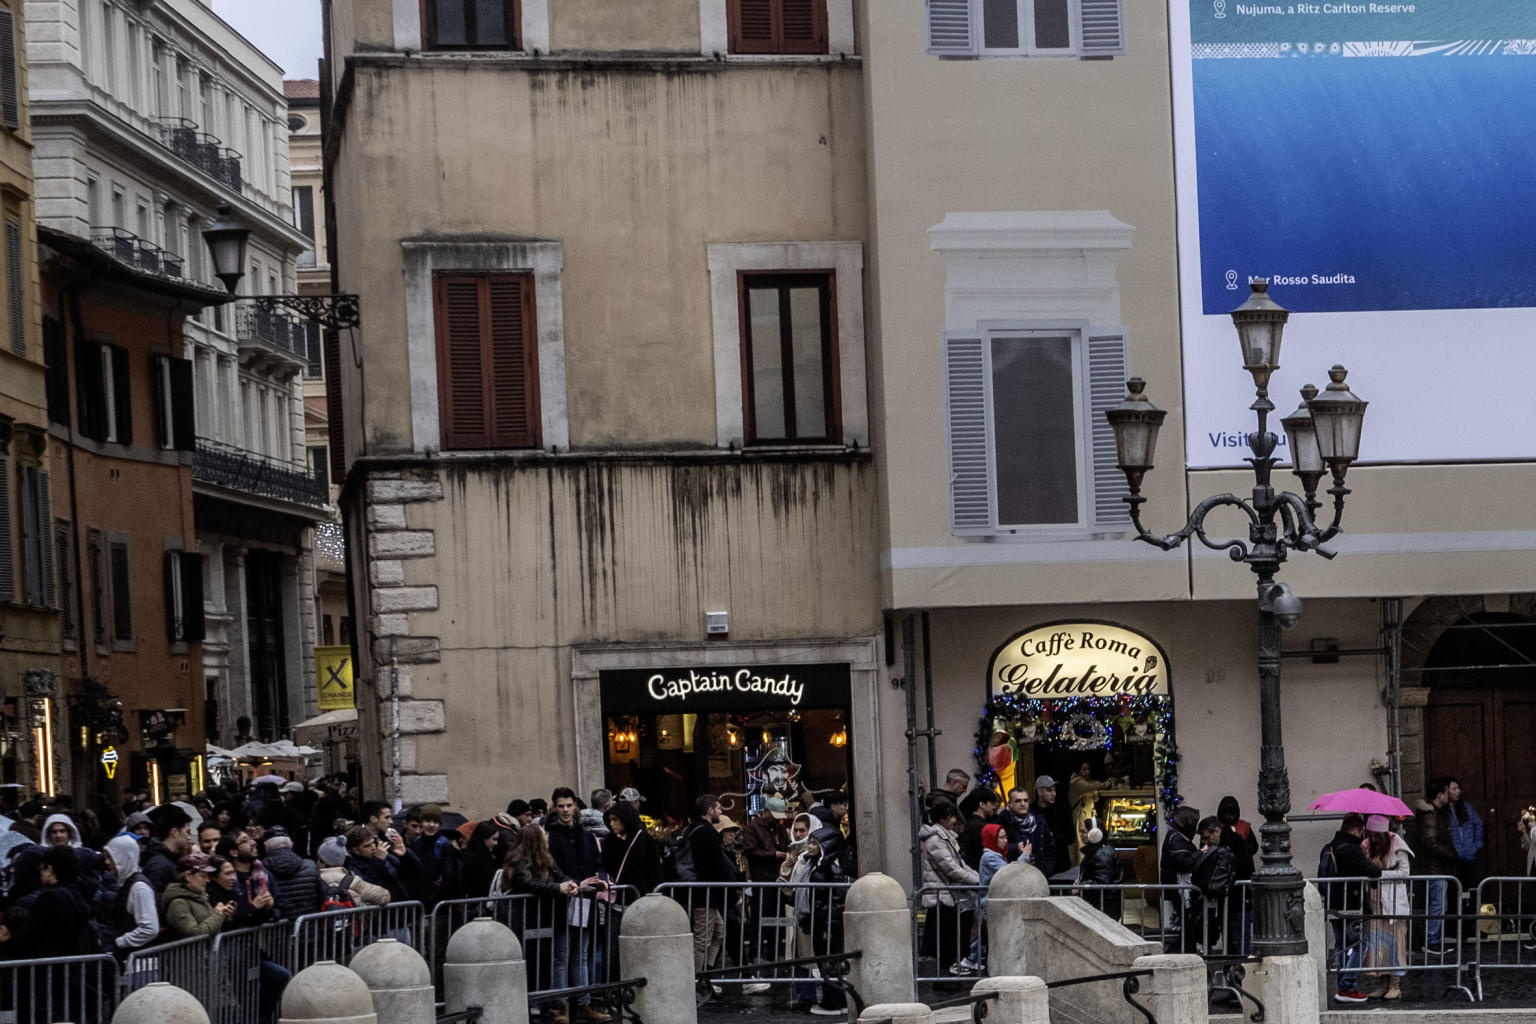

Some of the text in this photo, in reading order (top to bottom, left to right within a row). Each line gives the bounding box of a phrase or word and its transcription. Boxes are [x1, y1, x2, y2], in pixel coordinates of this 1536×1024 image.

[1236, 2, 1416, 15] Nujuma, a Ritz Carlton Reserve
[1273, 274, 1309, 286] Rosso
[1311, 272, 1356, 285] Saudita
[1020, 632, 1142, 659] Caffè Roma
[647, 668, 805, 705] Captain Candy
[998, 663, 1159, 695] Gelateria
